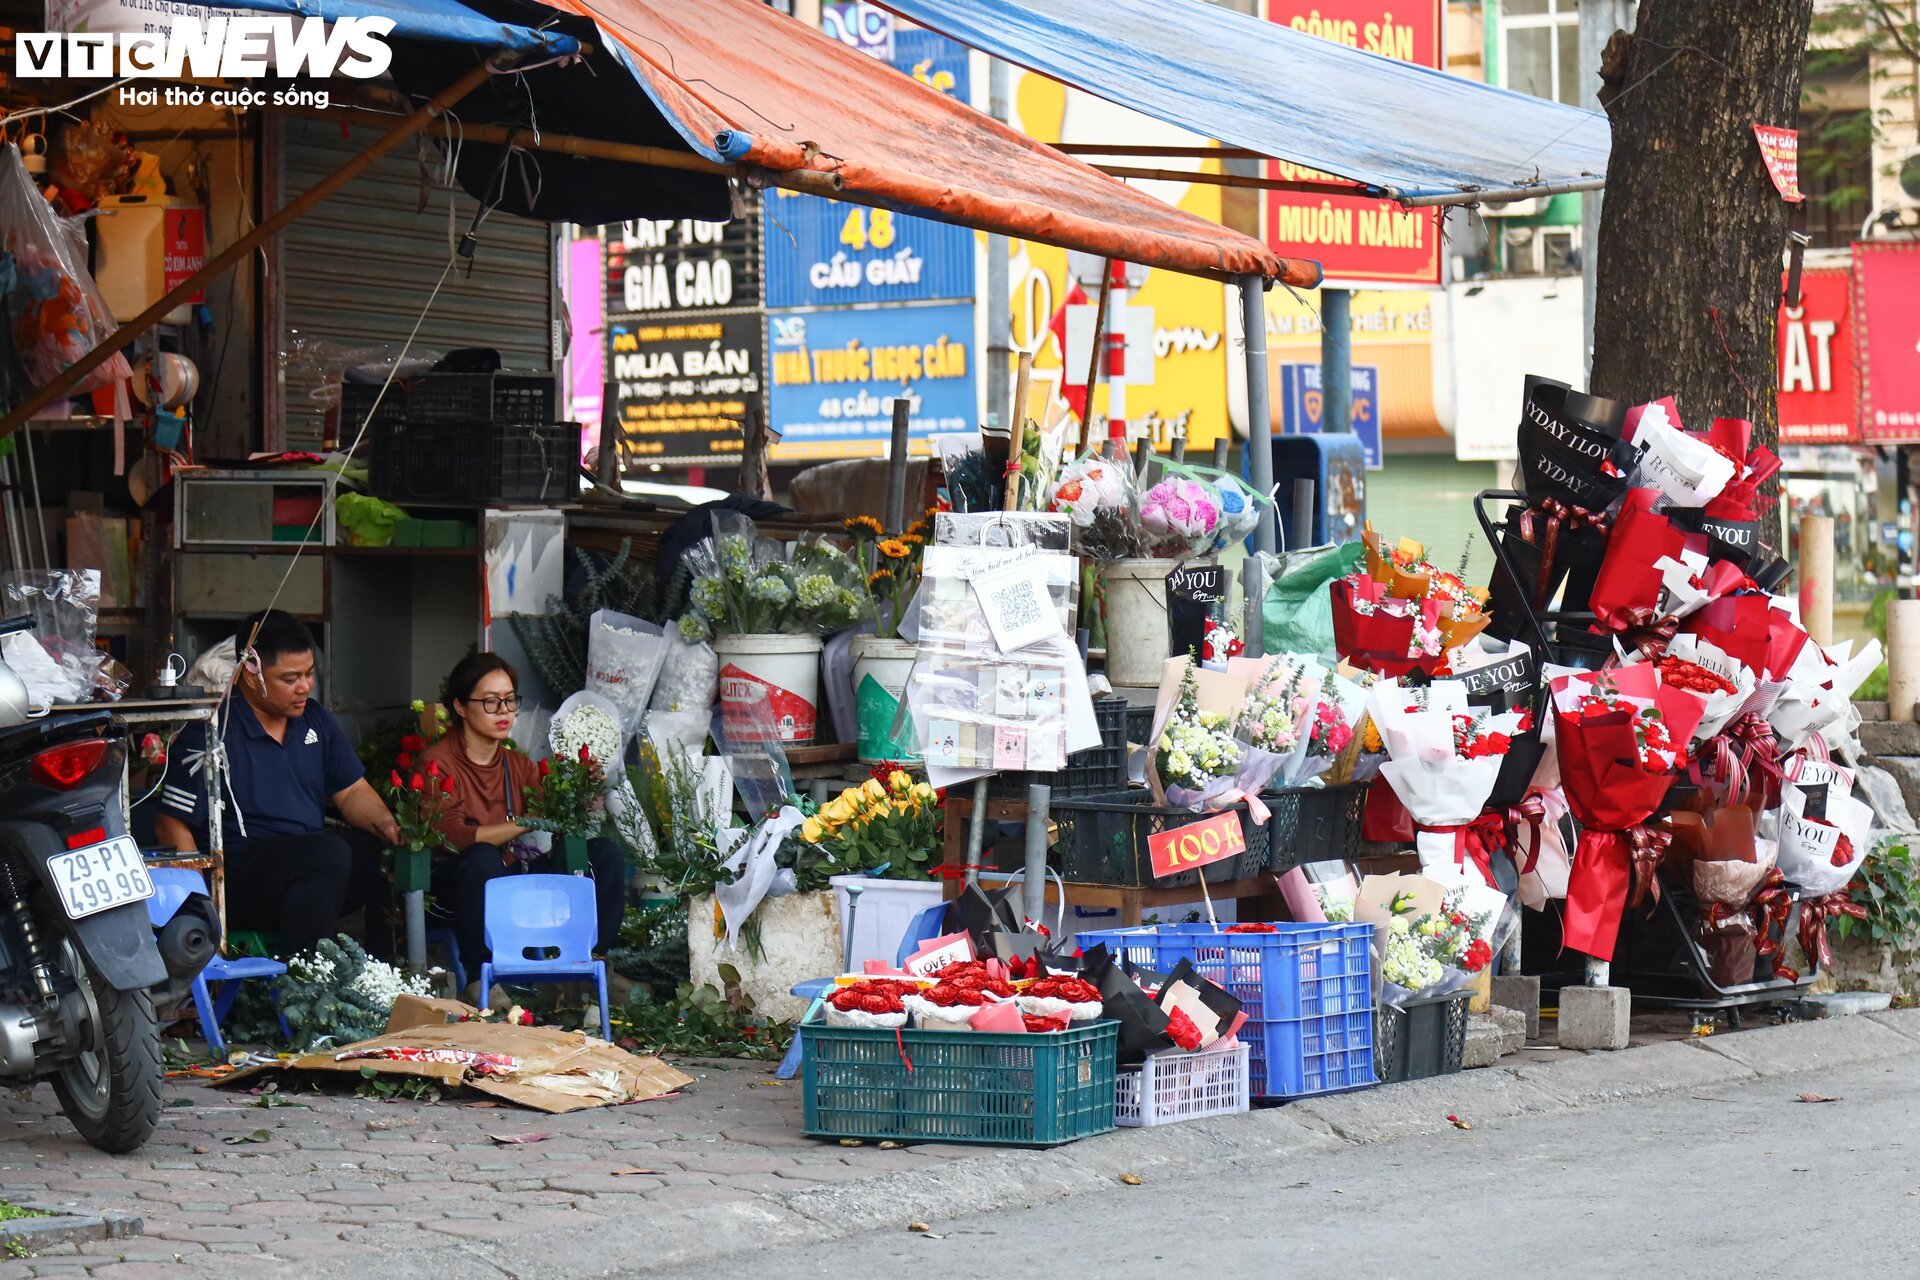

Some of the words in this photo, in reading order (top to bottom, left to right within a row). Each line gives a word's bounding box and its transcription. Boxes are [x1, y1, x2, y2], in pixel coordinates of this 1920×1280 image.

[840, 207, 896, 250] 48
[1279, 200, 1352, 246] MUÔN
[1359, 202, 1423, 249] NĂM!
[624, 252, 672, 312] GIÁ
[675, 258, 733, 307] CAO
[865, 246, 923, 286] GIẤY
[614, 352, 680, 379] MUA
[683, 339, 750, 376] BÁN
[1714, 525, 1752, 545] YOU
[1186, 571, 1217, 590] YOU
[1486, 659, 1525, 687] YOU
[782, 718, 793, 728] 18L
[1796, 821, 1832, 845] YOU
[63, 842, 128, 883] 29-P1
[69, 868, 147, 911] 499.96
